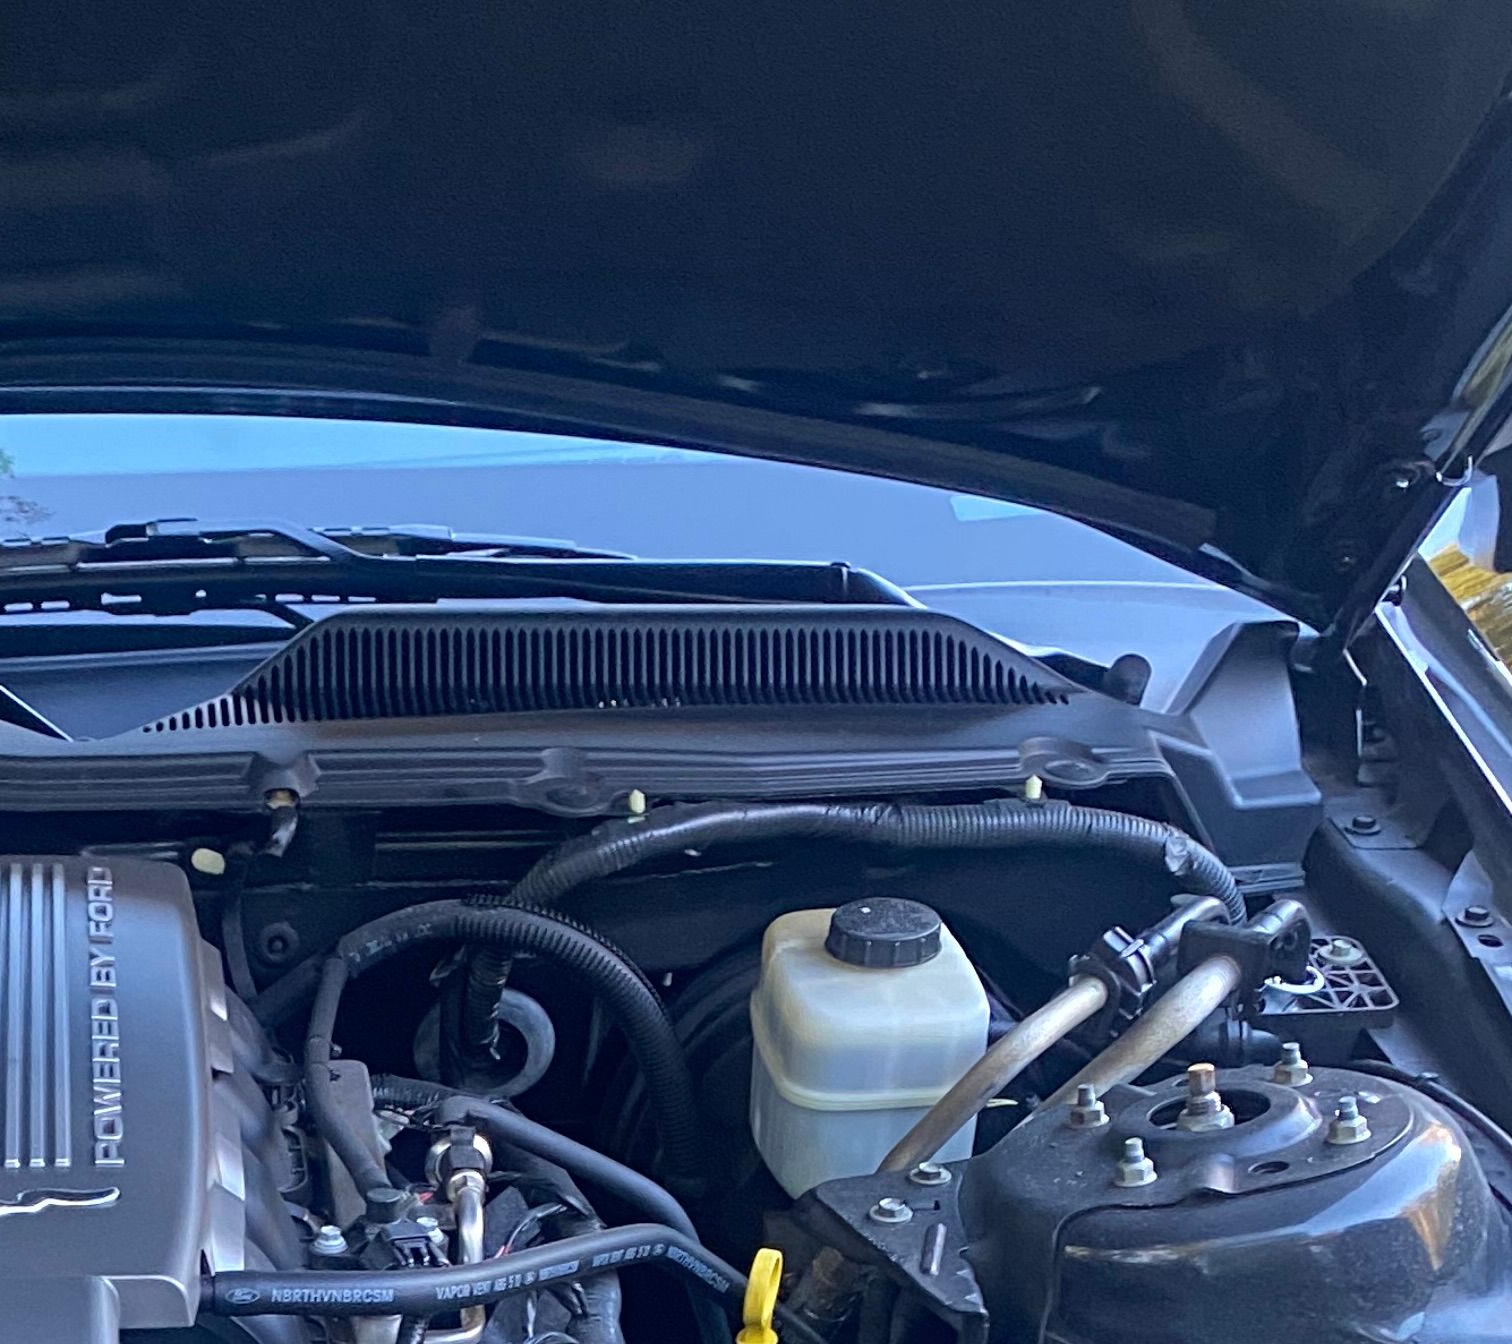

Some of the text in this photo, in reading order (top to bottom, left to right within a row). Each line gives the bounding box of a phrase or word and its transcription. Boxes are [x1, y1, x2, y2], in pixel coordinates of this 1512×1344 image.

[87, 866, 125, 1168] POWERED BY FORD
[271, 1288, 395, 1303] NBRTHVNBRCSM
[436, 1284, 472, 1300] VAPOR
